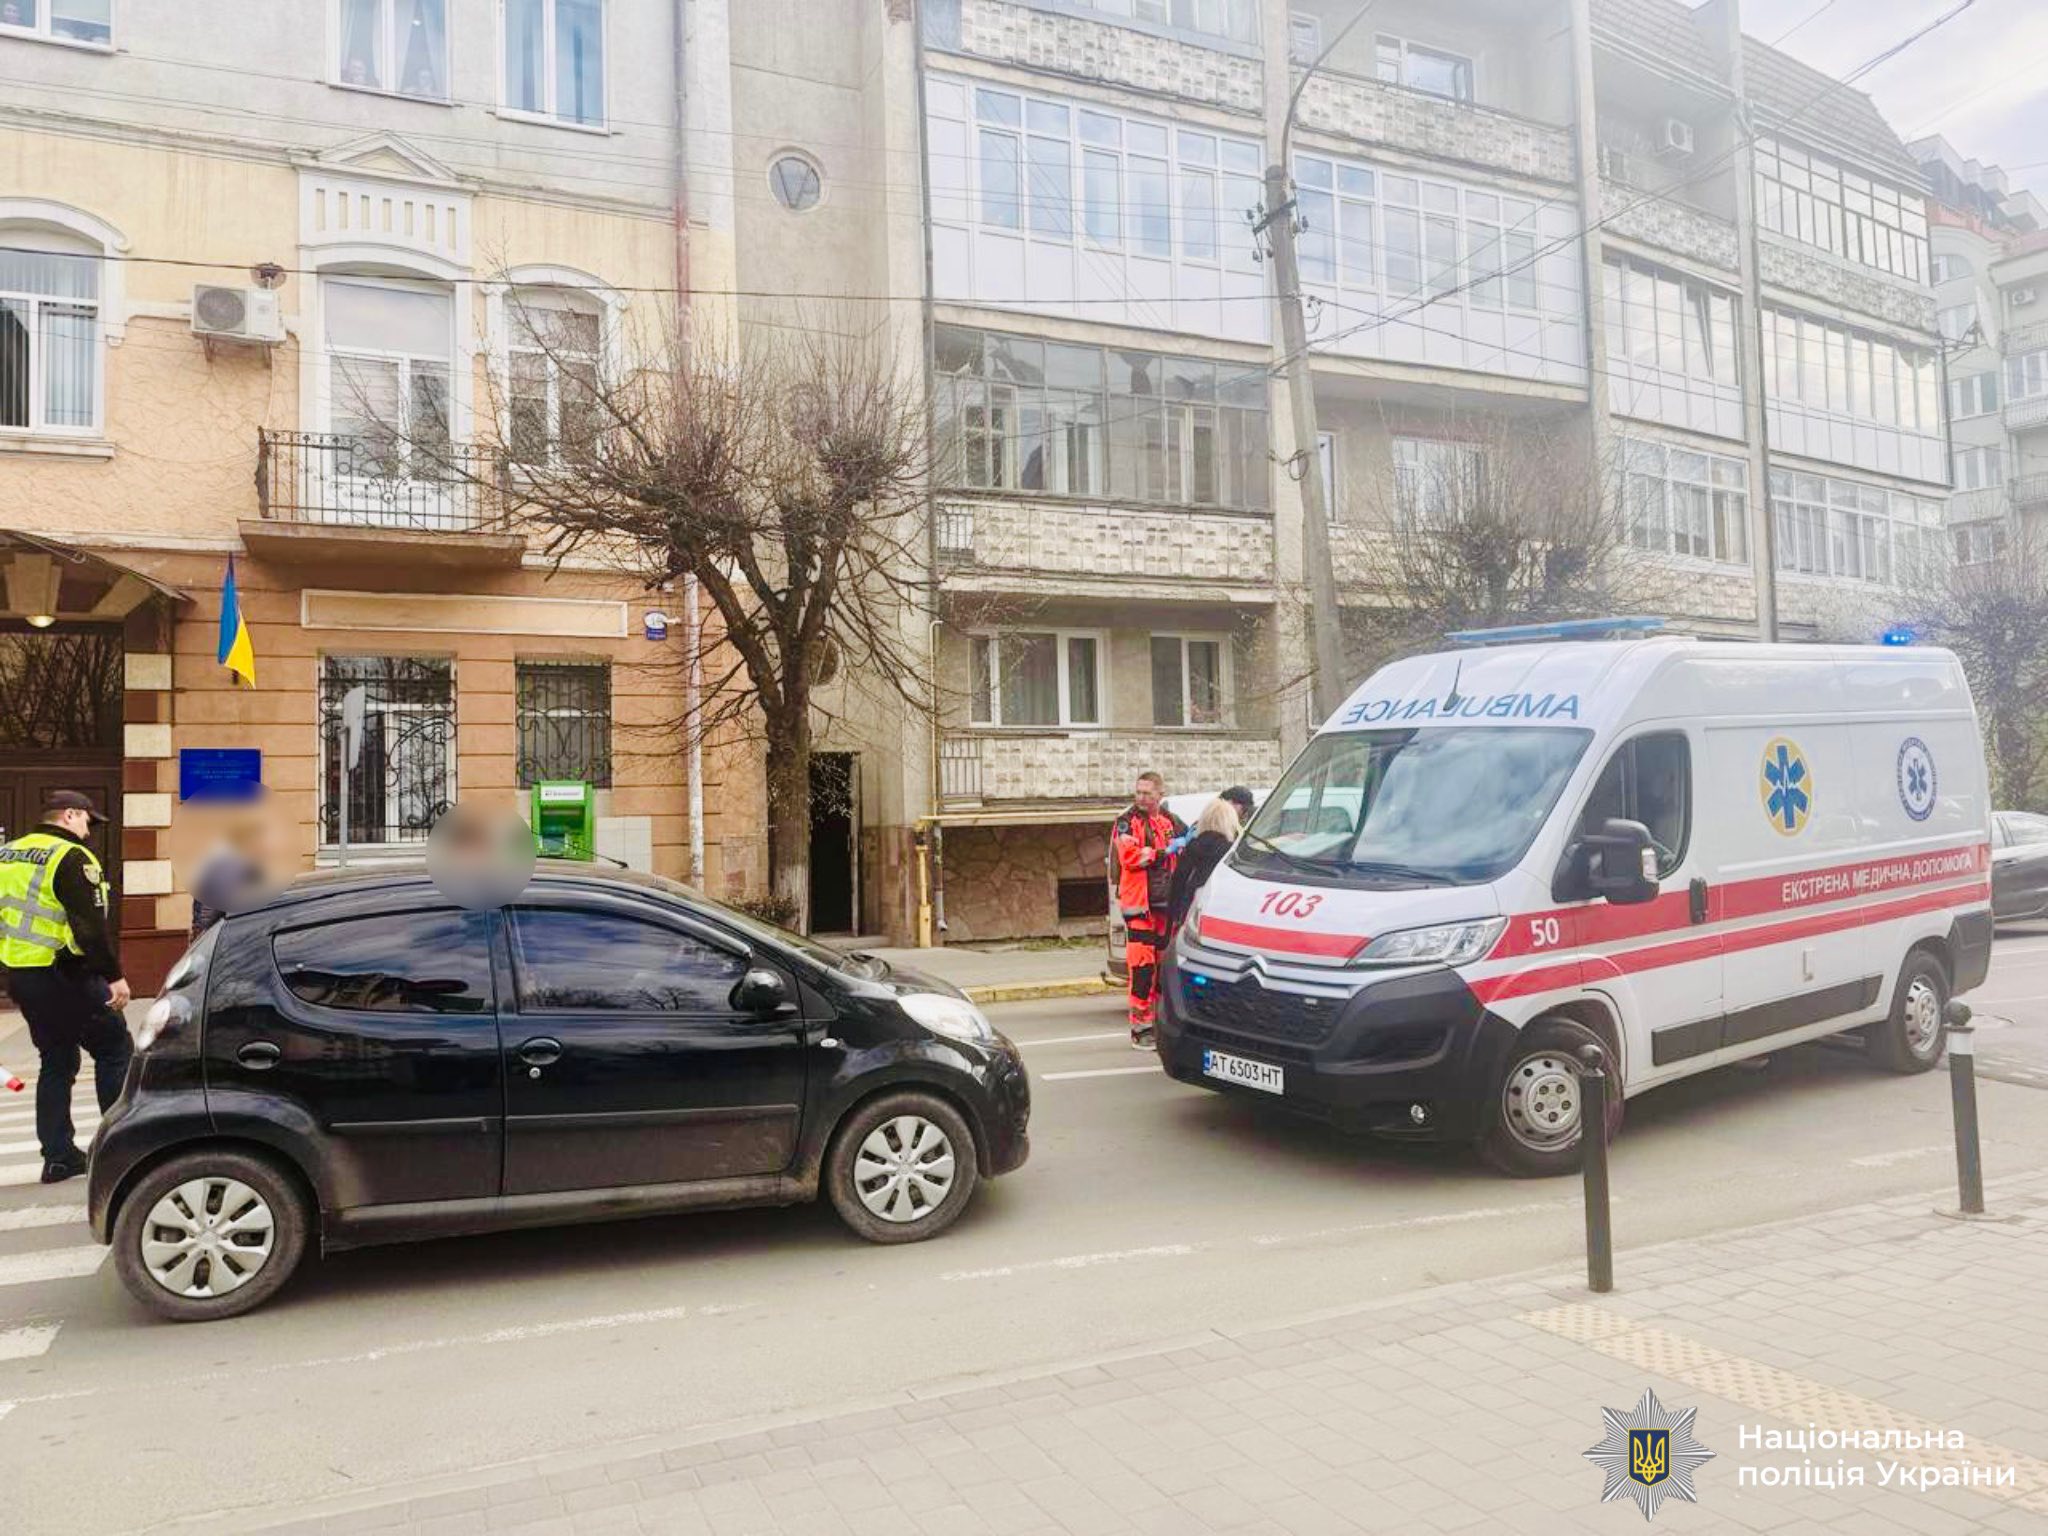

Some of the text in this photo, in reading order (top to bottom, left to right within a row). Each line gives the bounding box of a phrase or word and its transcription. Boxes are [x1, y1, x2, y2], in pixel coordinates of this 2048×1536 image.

[1781, 852, 1972, 903] ЕКСТРЕНА МЕДИЧНА ДОПОМОГА
[1260, 890, 1323, 918] 103
[1530, 917, 1559, 947] 50
[1210, 1053, 1281, 1086] AT 6503 HT
